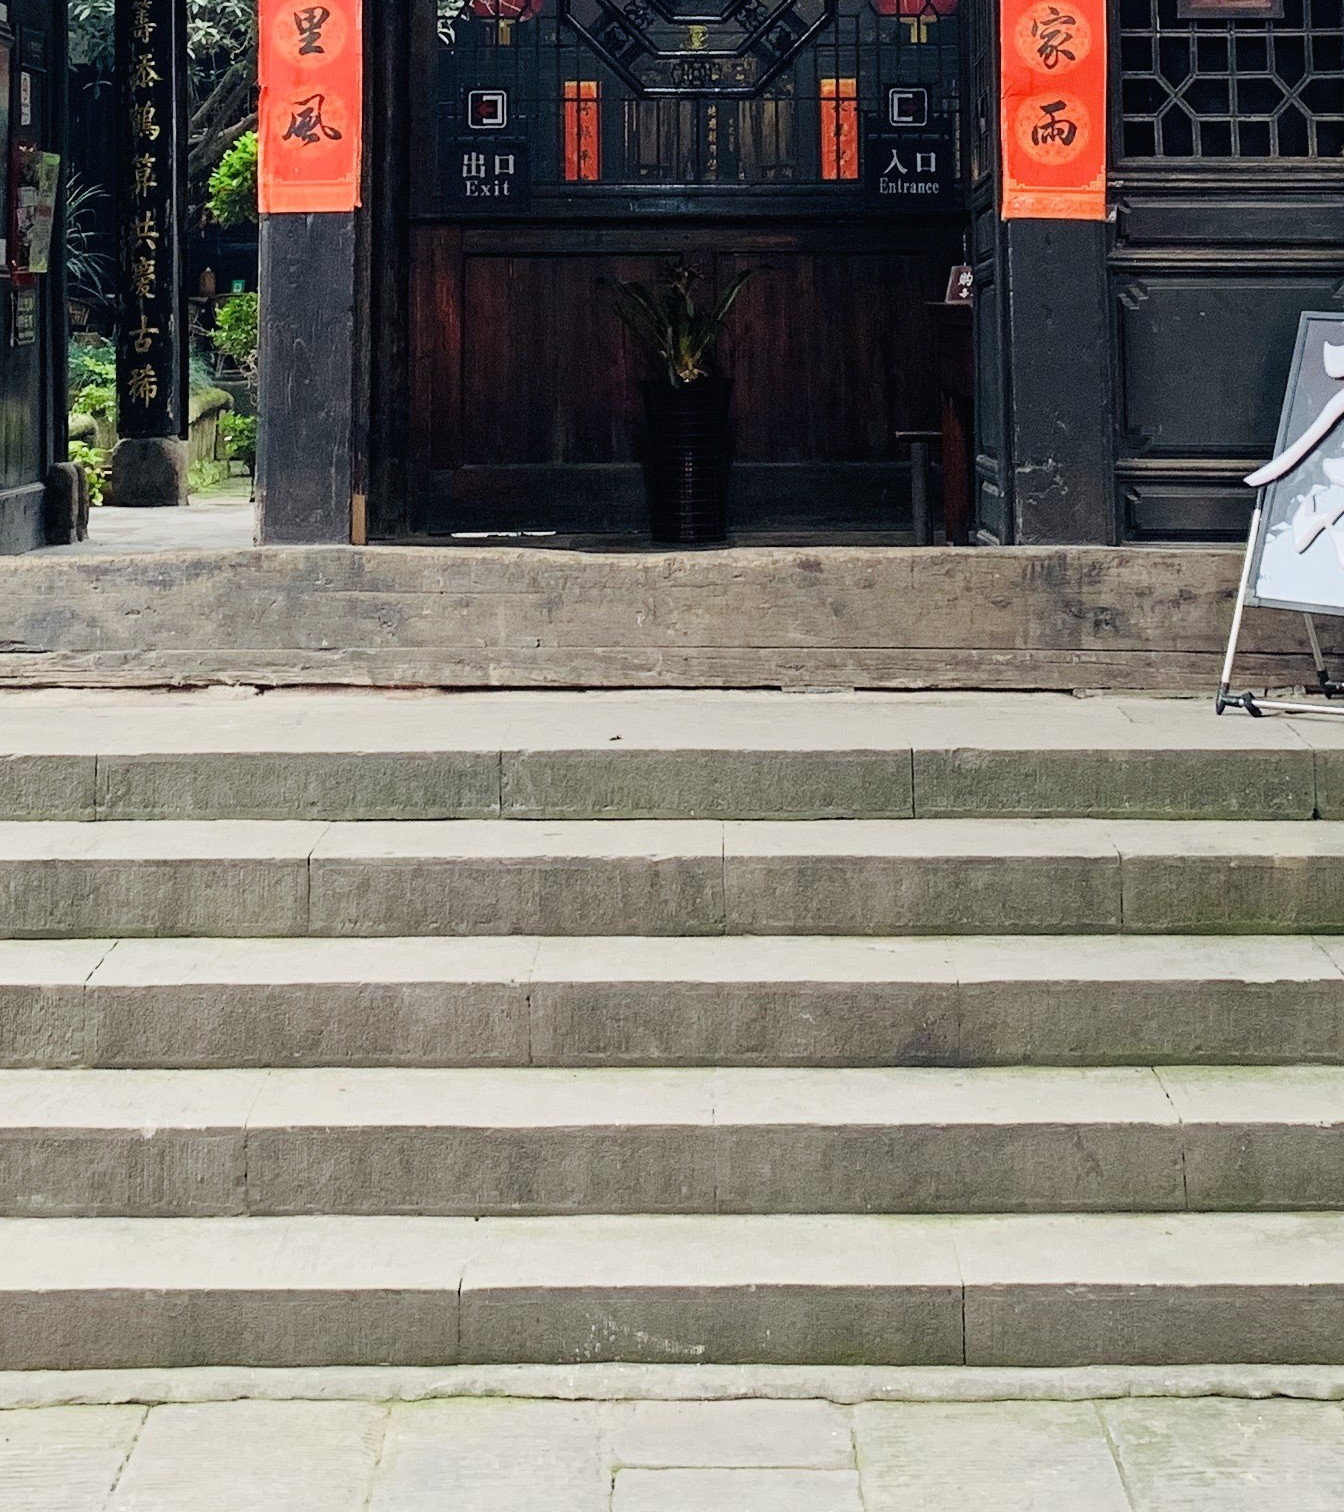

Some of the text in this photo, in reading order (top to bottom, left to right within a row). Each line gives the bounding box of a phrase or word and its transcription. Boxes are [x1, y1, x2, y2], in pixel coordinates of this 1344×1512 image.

[461, 151, 516, 178] 出口
[883, 148, 936, 174] 入口
[464, 179, 511, 198] Exit
[878, 177, 940, 195] Entrance
